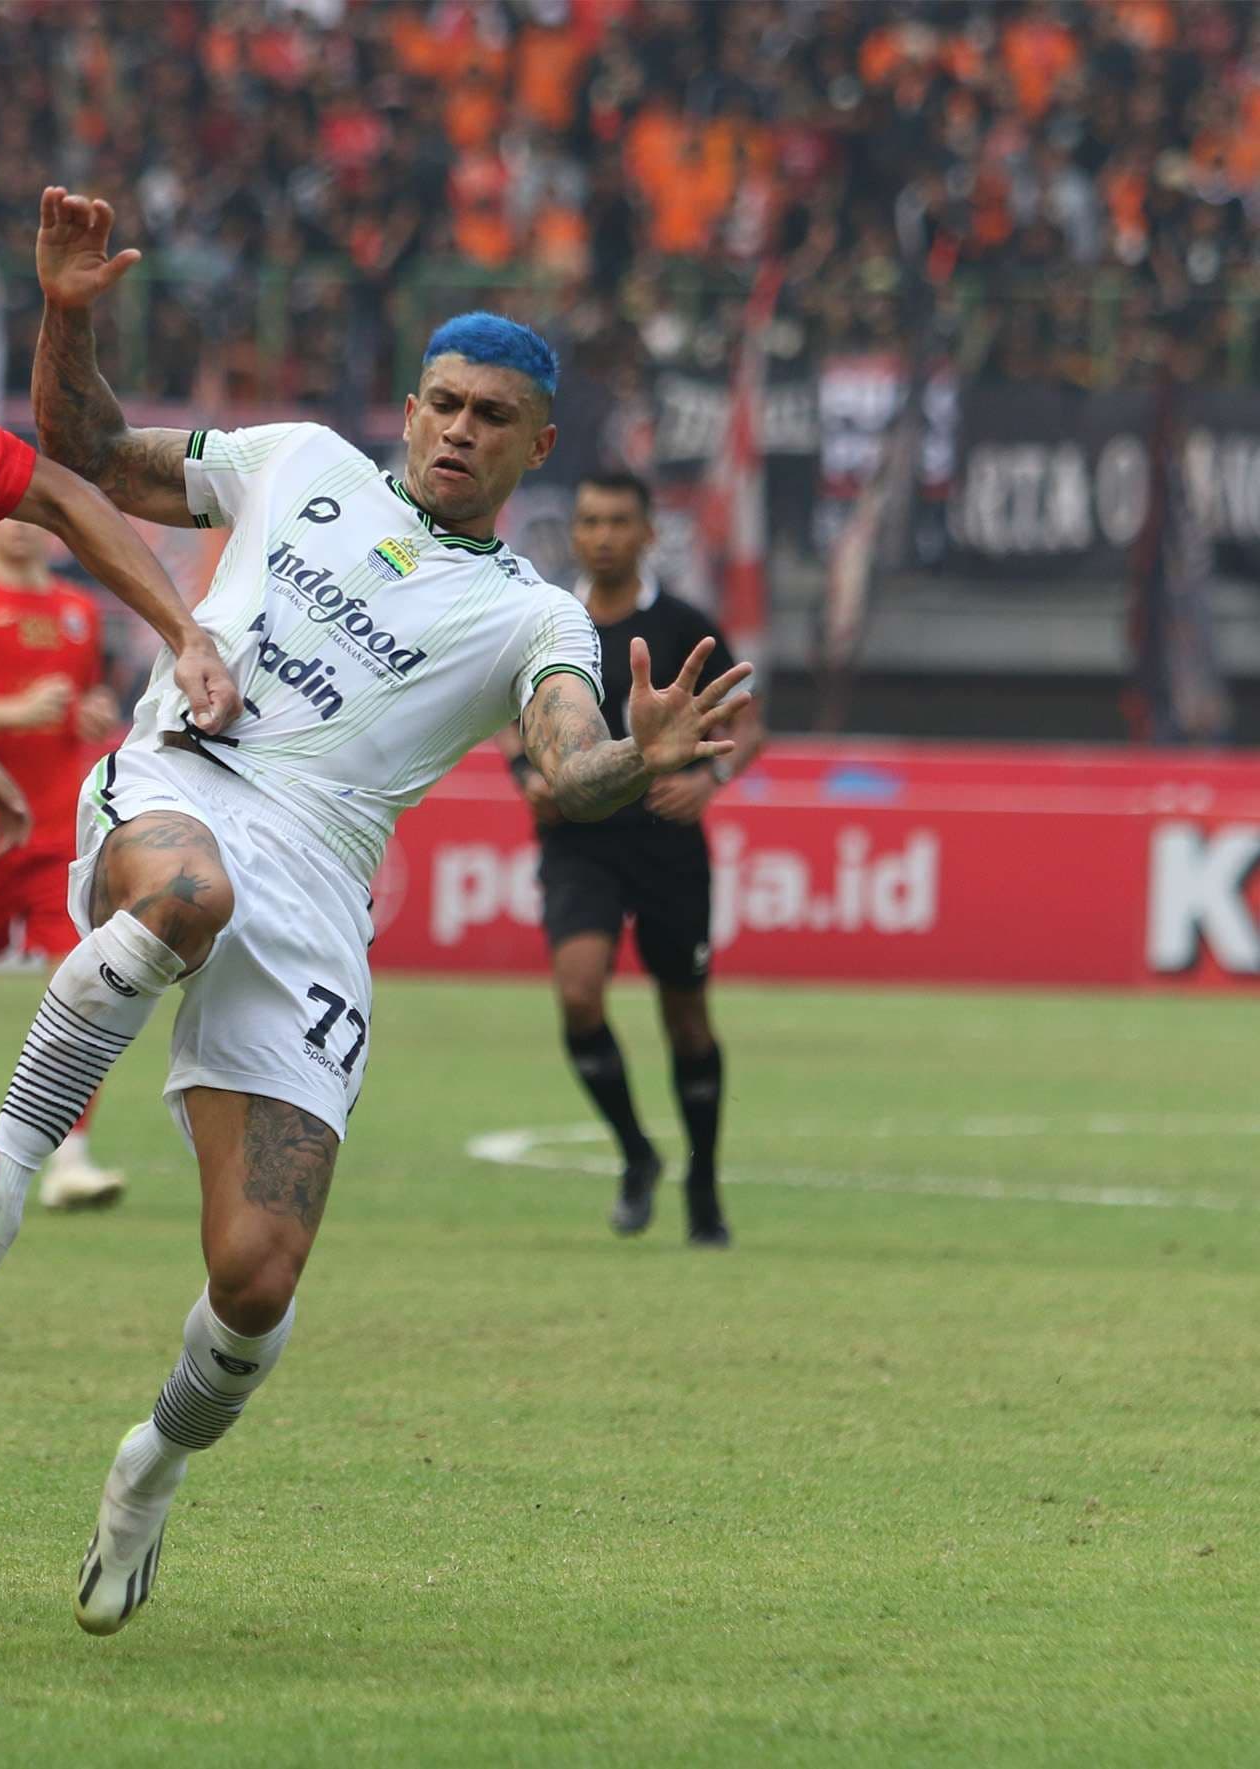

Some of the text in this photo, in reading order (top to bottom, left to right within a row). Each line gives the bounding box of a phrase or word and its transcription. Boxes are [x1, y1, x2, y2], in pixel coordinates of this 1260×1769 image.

[386, 540, 415, 569] PERSIB
[267, 541, 428, 678] Indofood
[430, 824, 939, 948] peja.id
[304, 982, 367, 1075] 77
